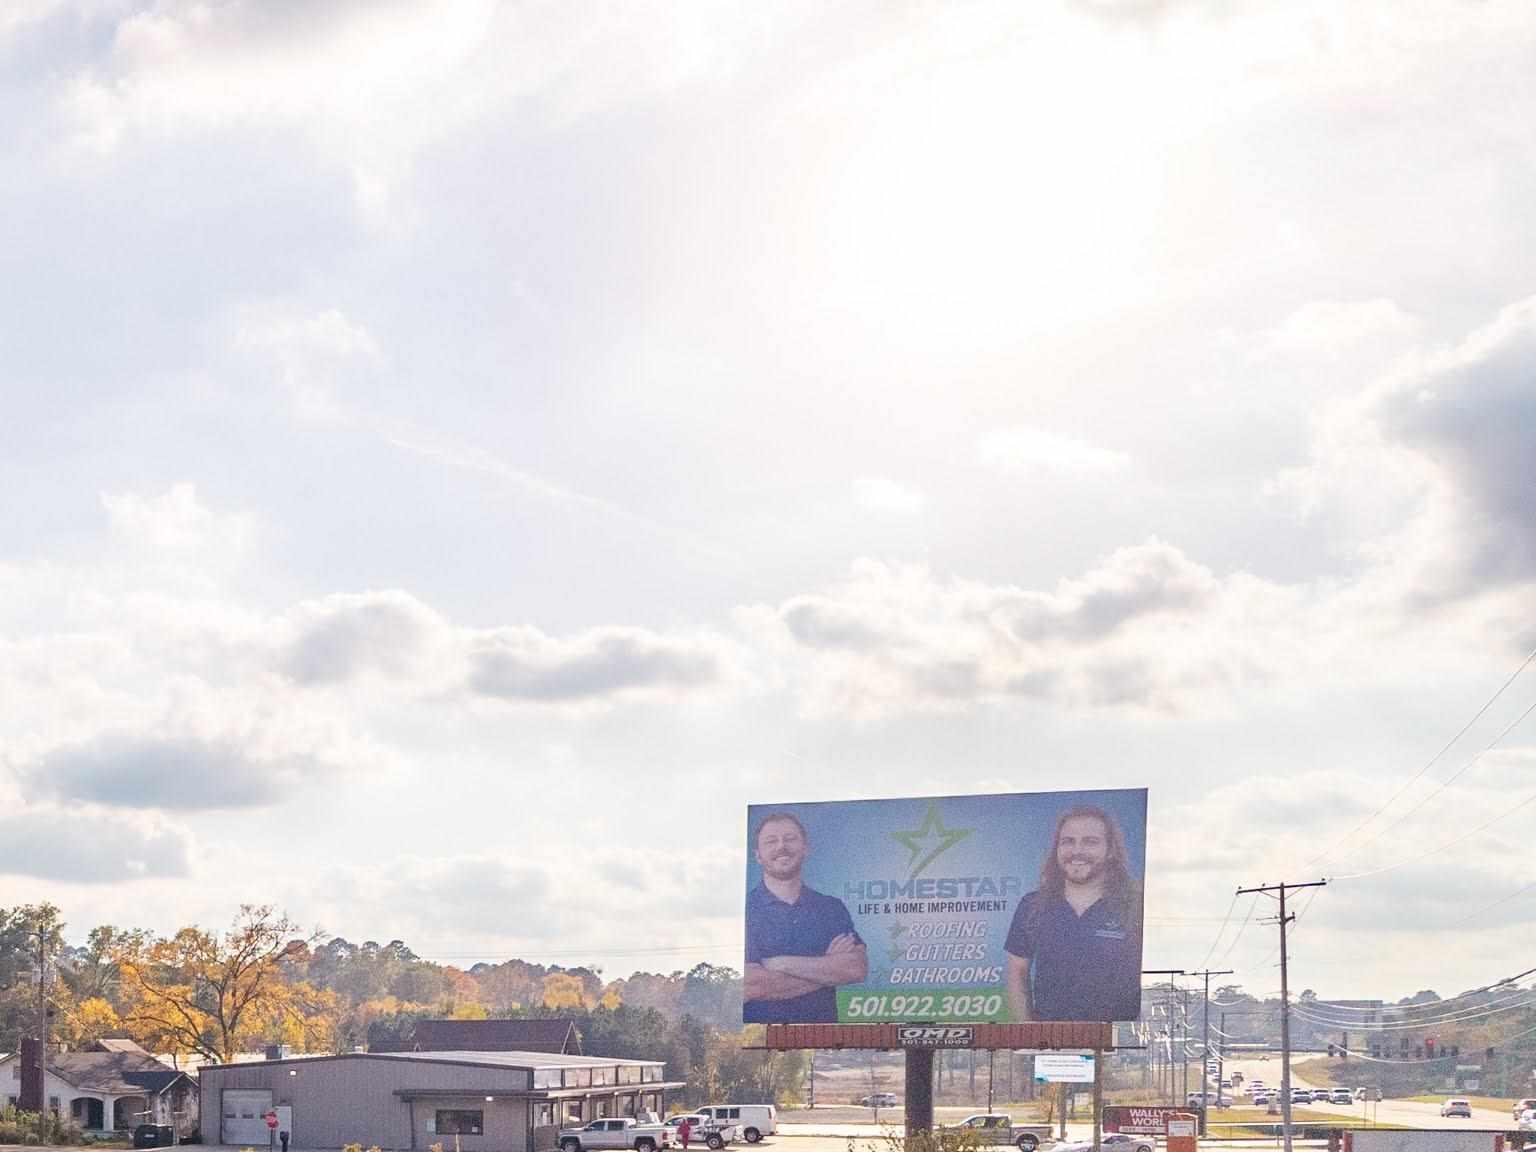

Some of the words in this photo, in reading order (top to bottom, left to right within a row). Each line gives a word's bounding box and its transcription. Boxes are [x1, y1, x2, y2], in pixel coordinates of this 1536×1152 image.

[844, 877, 1022, 900] HOMESTAR
[858, 903, 880, 915] LIFE
[883, 902, 891, 914] &
[894, 901, 925, 914] HOME
[927, 900, 1008, 913] IMPROVEMENT
[907, 920, 987, 938] ROOFING
[904, 943, 987, 961] GUTTERS
[889, 966, 1003, 984] BATHROOMS
[847, 995, 1002, 1017] 501.922.3030
[903, 1028, 967, 1039] OMD
[1132, 1118, 1167, 1127] WORL
